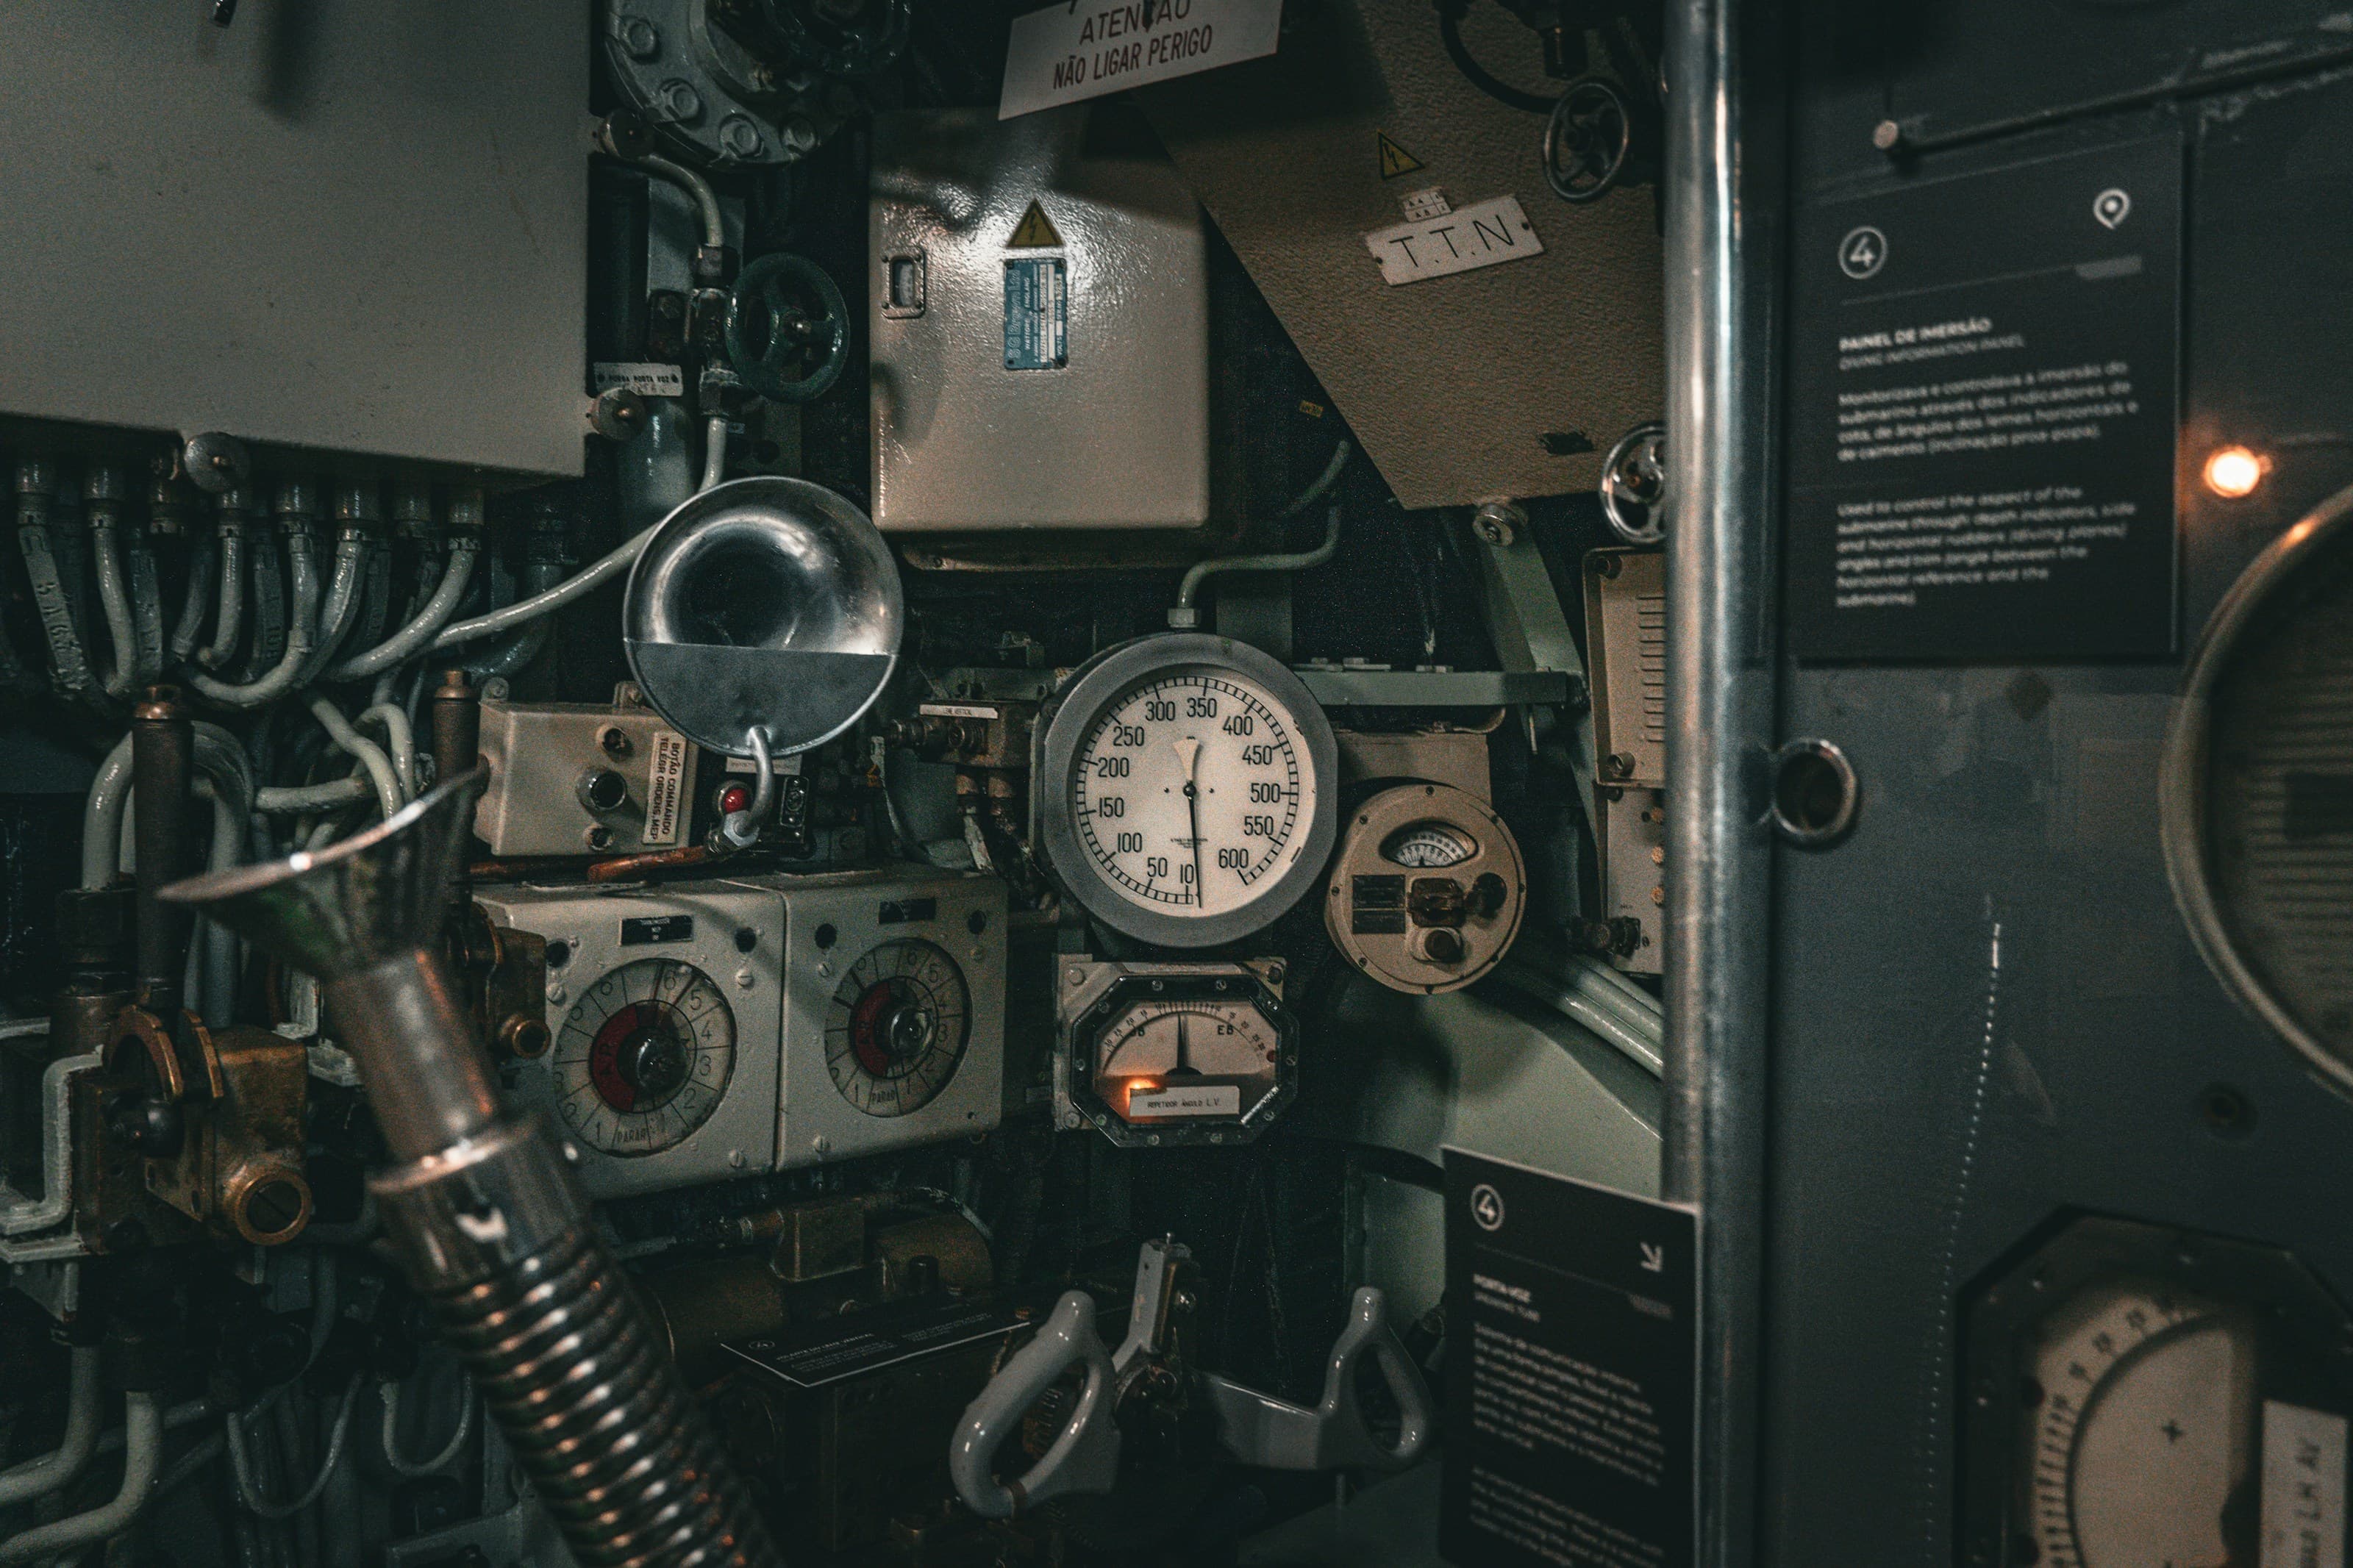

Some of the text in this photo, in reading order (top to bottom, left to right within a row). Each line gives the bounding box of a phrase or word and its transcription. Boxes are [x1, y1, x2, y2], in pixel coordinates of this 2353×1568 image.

[1053, 24, 1213, 90] NÃO LIGAR PERIGO
[1894, 329, 1916, 345] DE
[1145, 701, 1176, 721] 300
[1186, 698, 1217, 718] 350
[1222, 715, 1254, 736] 400
[1113, 726, 1145, 747] 250
[1242, 745, 1273, 765] 450
[1098, 757, 1130, 778] 200
[662, 742, 681, 835] BOTÃO COMMANDO
[1250, 783, 1281, 803] 500
[1099, 797, 1124, 817] 150
[1243, 815, 1274, 836] 550
[1117, 832, 1143, 853] 100
[1146, 856, 1168, 877] 50
[1218, 848, 1249, 869] 600
[1179, 864, 1194, 884] 10
[689, 989, 702, 1011] 5
[701, 1020, 713, 1042] 4
[1217, 1024, 1234, 1035] EB
[699, 1055, 712, 1076] 3
[683, 1087, 697, 1111] 2
